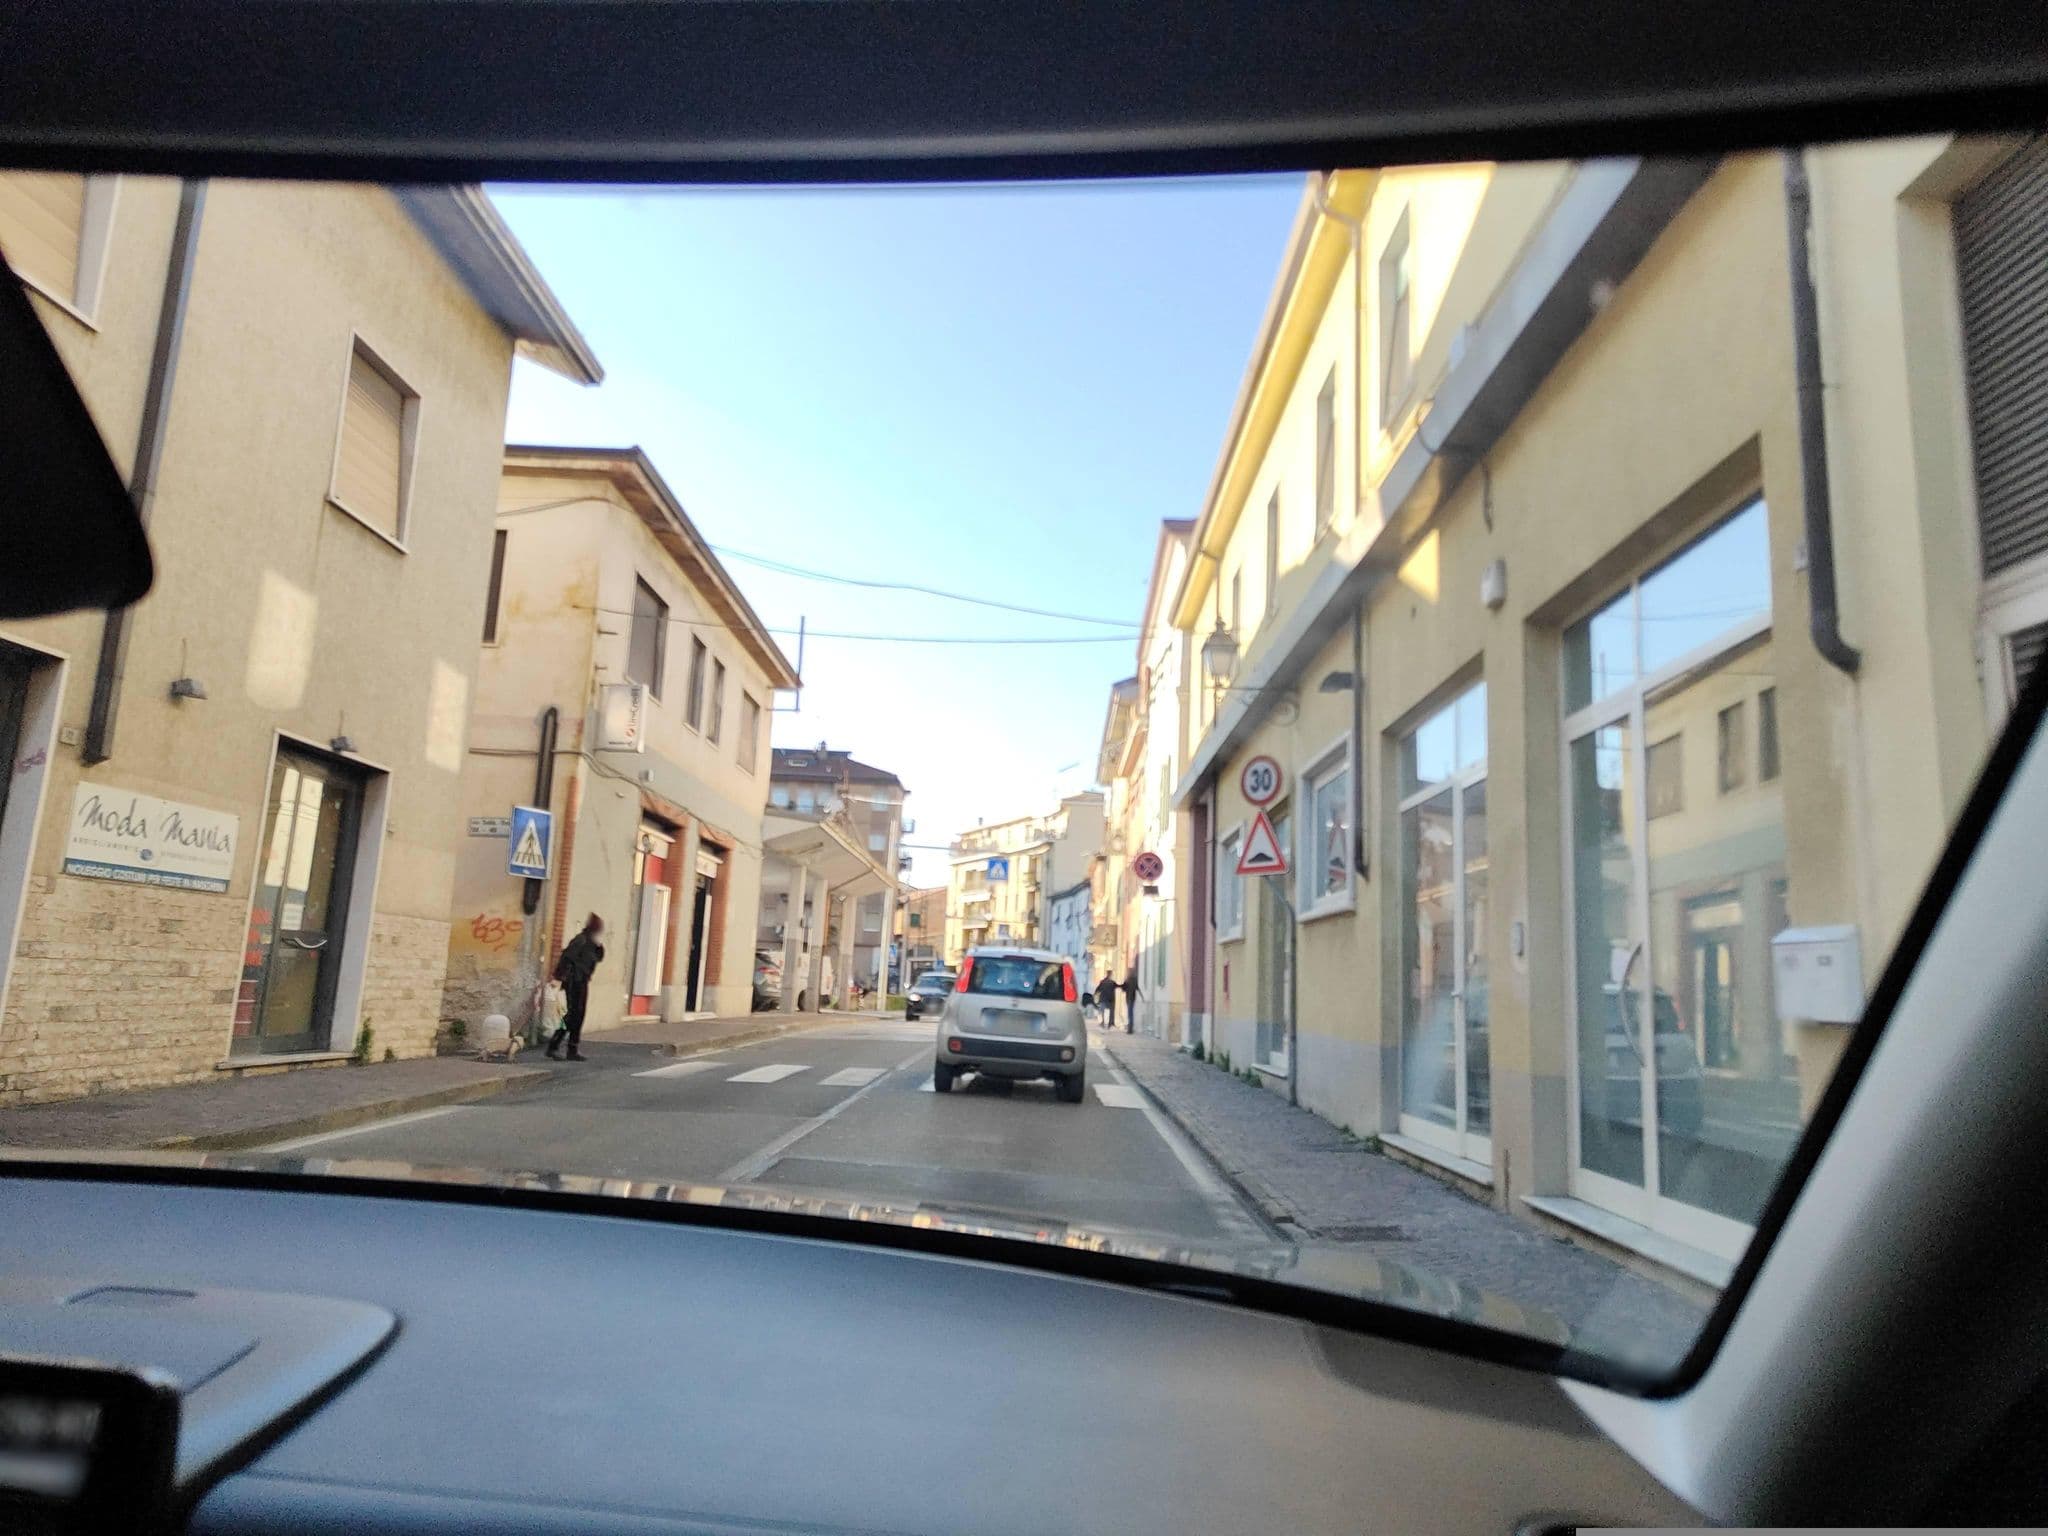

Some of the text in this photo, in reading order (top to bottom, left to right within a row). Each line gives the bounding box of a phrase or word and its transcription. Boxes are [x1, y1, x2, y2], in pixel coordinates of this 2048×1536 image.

[1250, 768, 1272, 793] 30
[79, 795, 231, 853] Moda Mania
